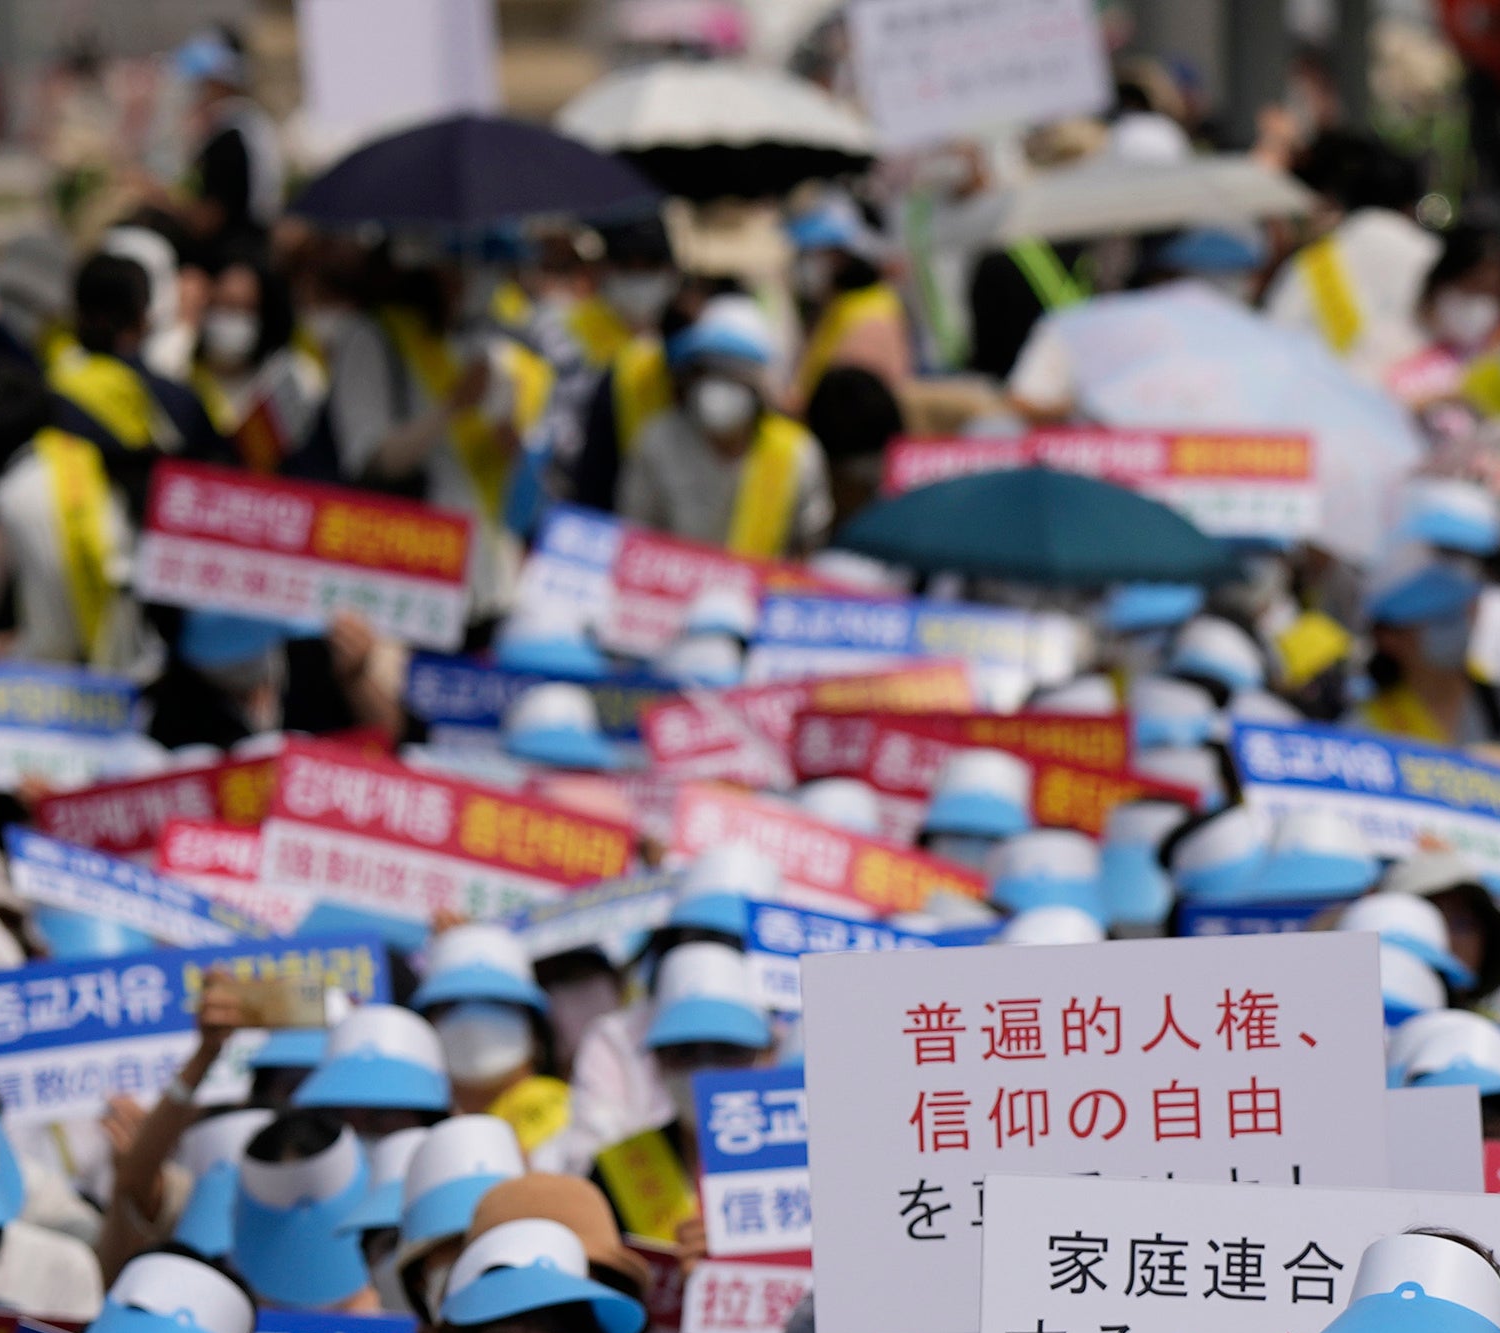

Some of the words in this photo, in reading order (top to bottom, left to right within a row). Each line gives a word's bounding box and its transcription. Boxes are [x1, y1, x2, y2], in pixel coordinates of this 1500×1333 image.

[901, 987, 1319, 1066] 普遍的人権、
[907, 1075, 1286, 1154] 信仰の自由
[1046, 1230, 1346, 1305] 家庭連合
